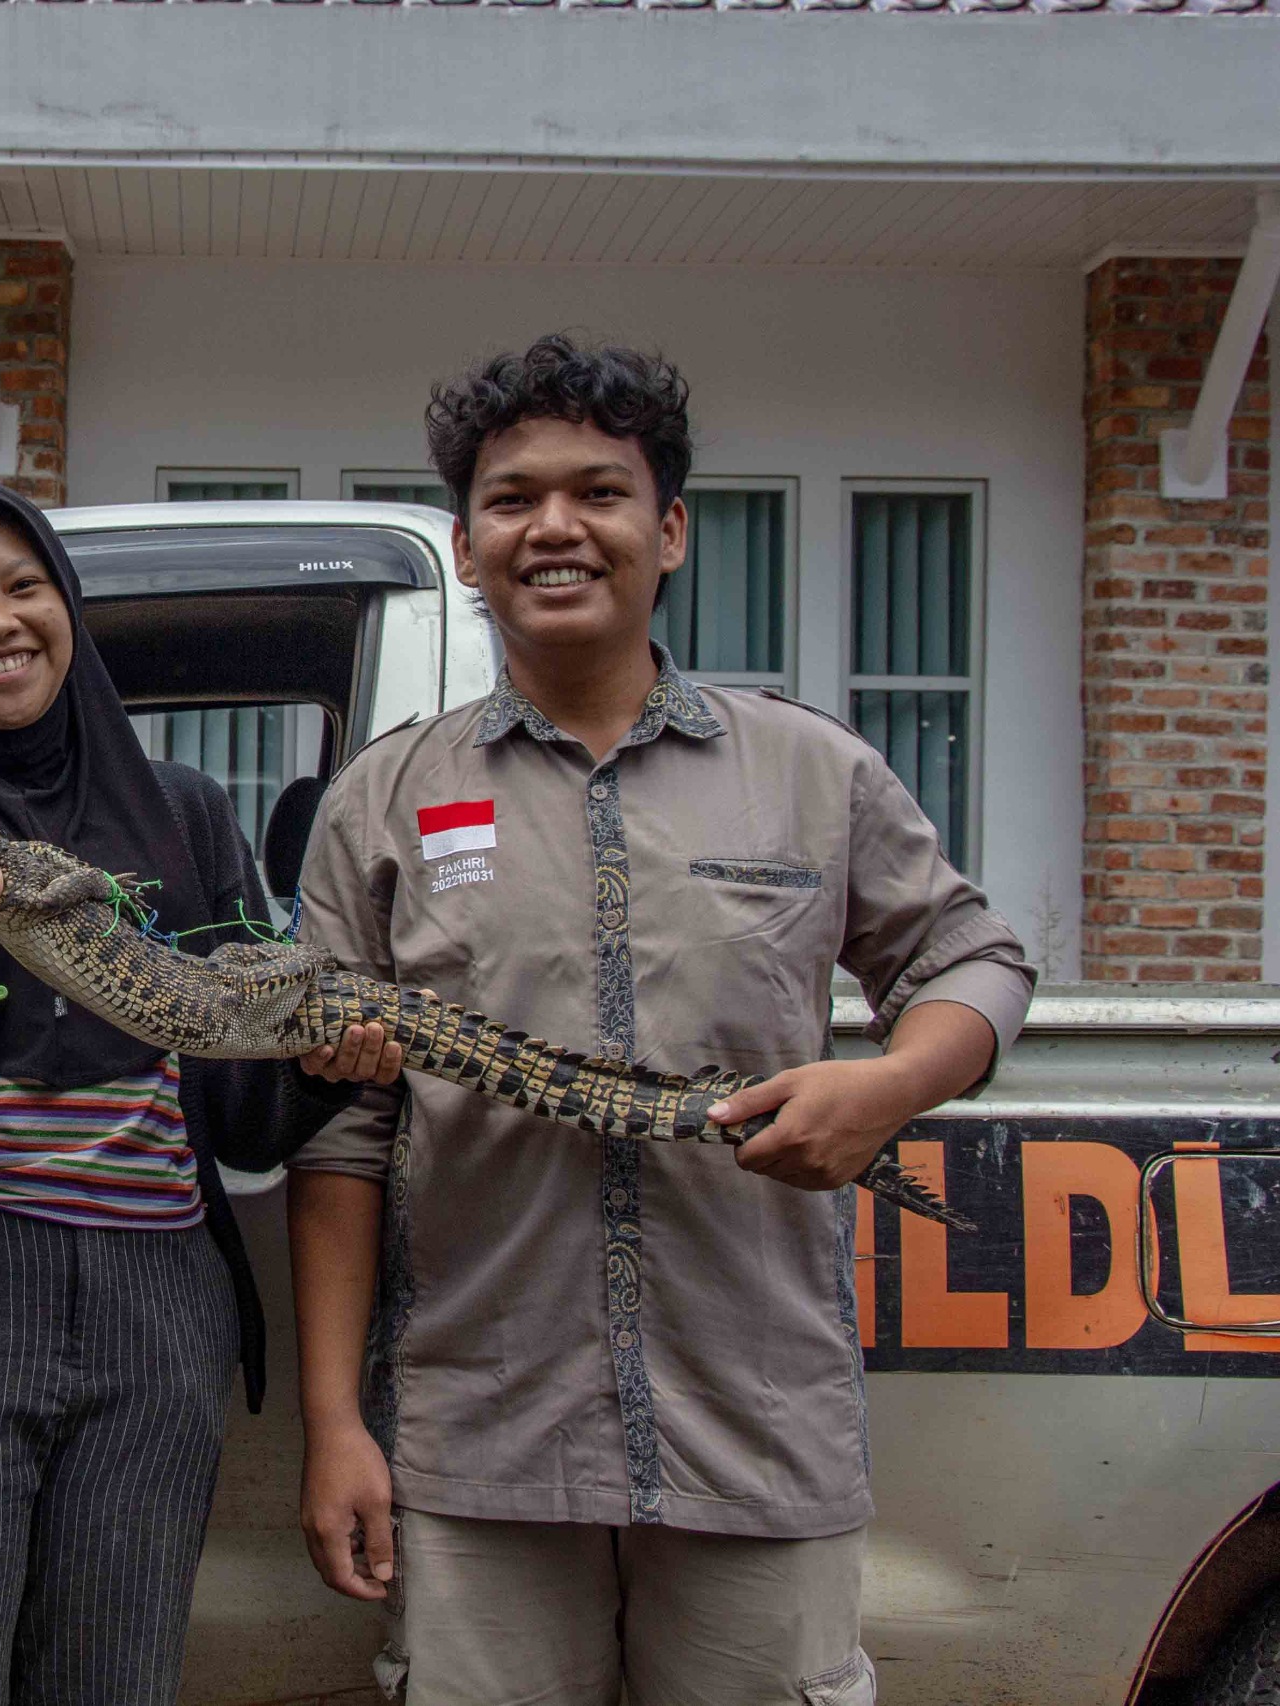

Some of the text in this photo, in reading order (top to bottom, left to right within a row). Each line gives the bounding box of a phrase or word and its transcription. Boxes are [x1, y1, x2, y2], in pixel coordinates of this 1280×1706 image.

[299, 560, 353, 571] HILUX
[438, 857, 486, 877] FAKHRI
[431, 869, 494, 893] 2022111031
